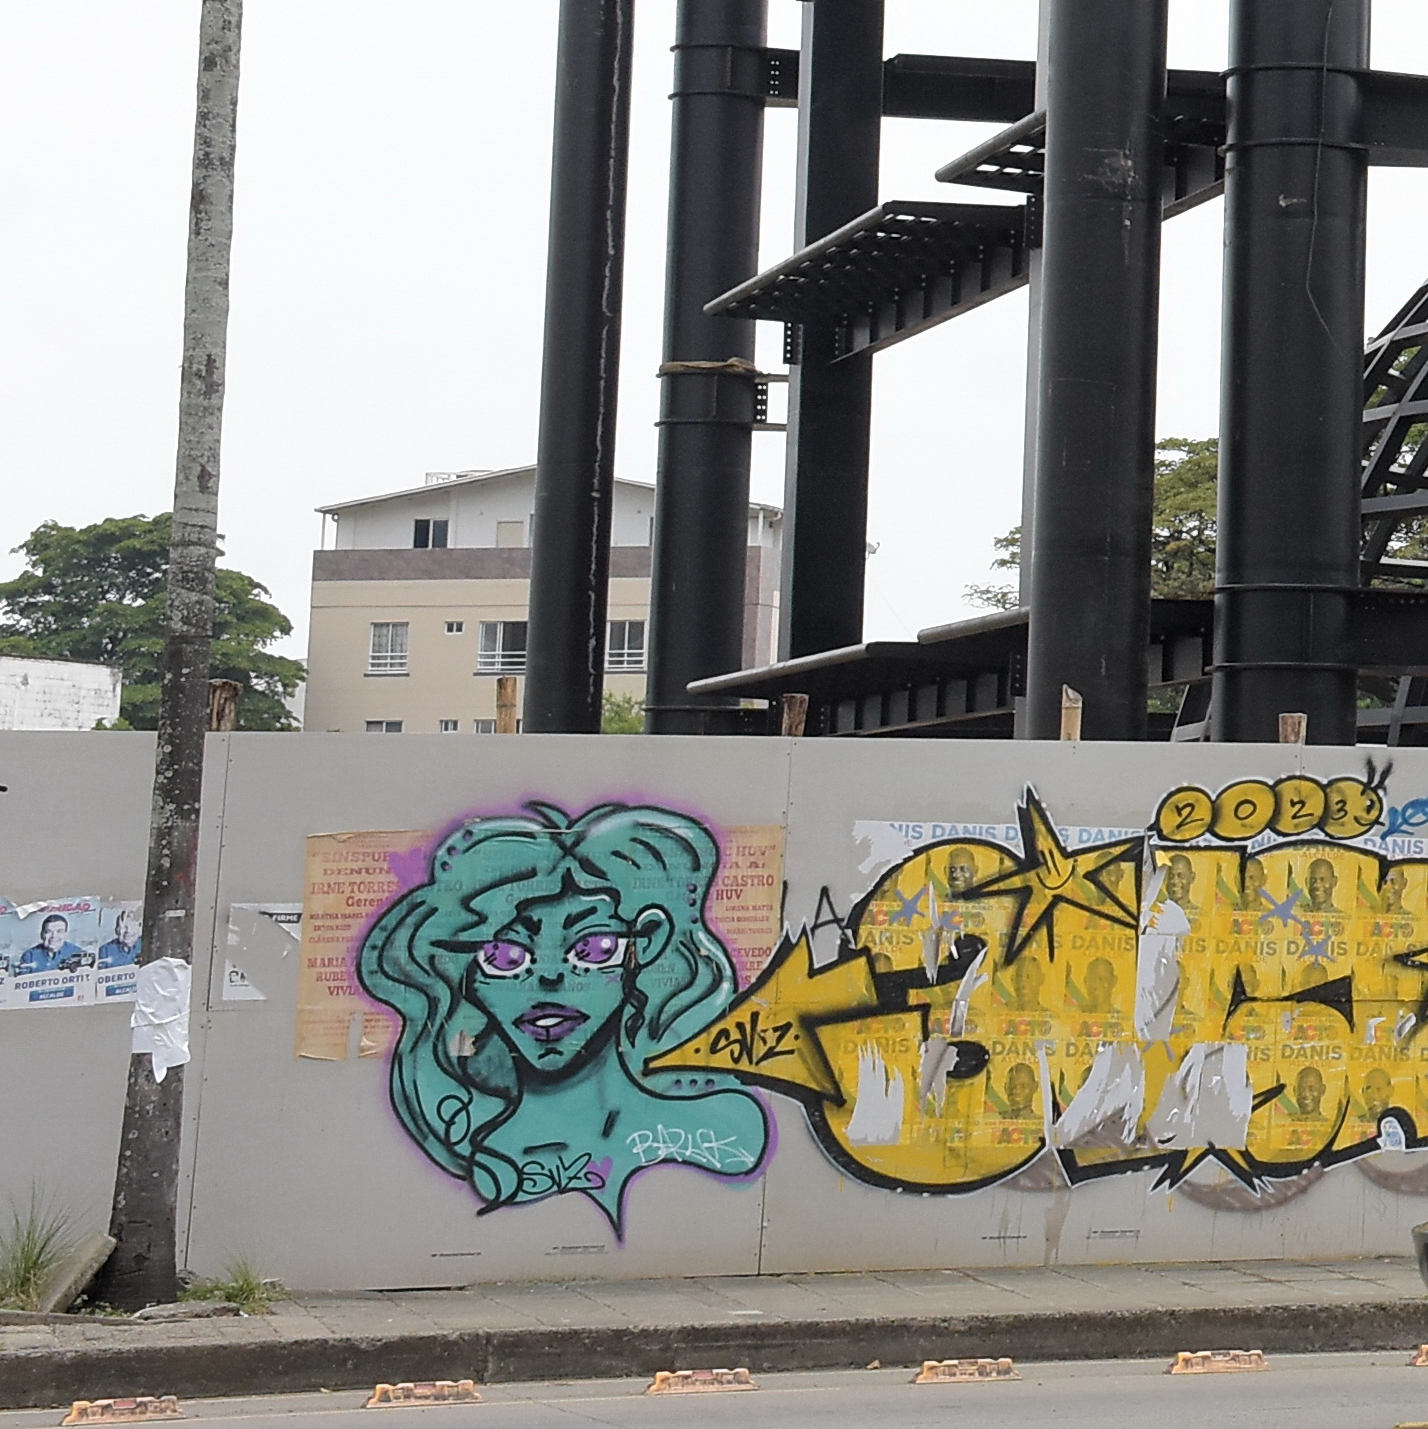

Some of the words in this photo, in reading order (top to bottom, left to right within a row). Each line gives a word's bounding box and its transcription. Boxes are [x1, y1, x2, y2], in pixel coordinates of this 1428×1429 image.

[1174, 798, 1348, 830] 2023
[889, 822, 923, 840] NIS
[1363, 838, 1425, 855] DANIS
[310, 881, 346, 894] IRNE
[721, 874, 775, 888] CASTRO
[715, 888, 744, 901] HUV
[1070, 934, 1136, 952] DANIS
[1215, 939, 1277, 957] DANIS
[14, 976, 60, 990] ROBERTO
[97, 972, 136, 984] OBERTO
[991, 1039, 1056, 1058] DANS
[1280, 1044, 1343, 1061] DANIS
[1352, 1046, 1411, 1063] DANIS
